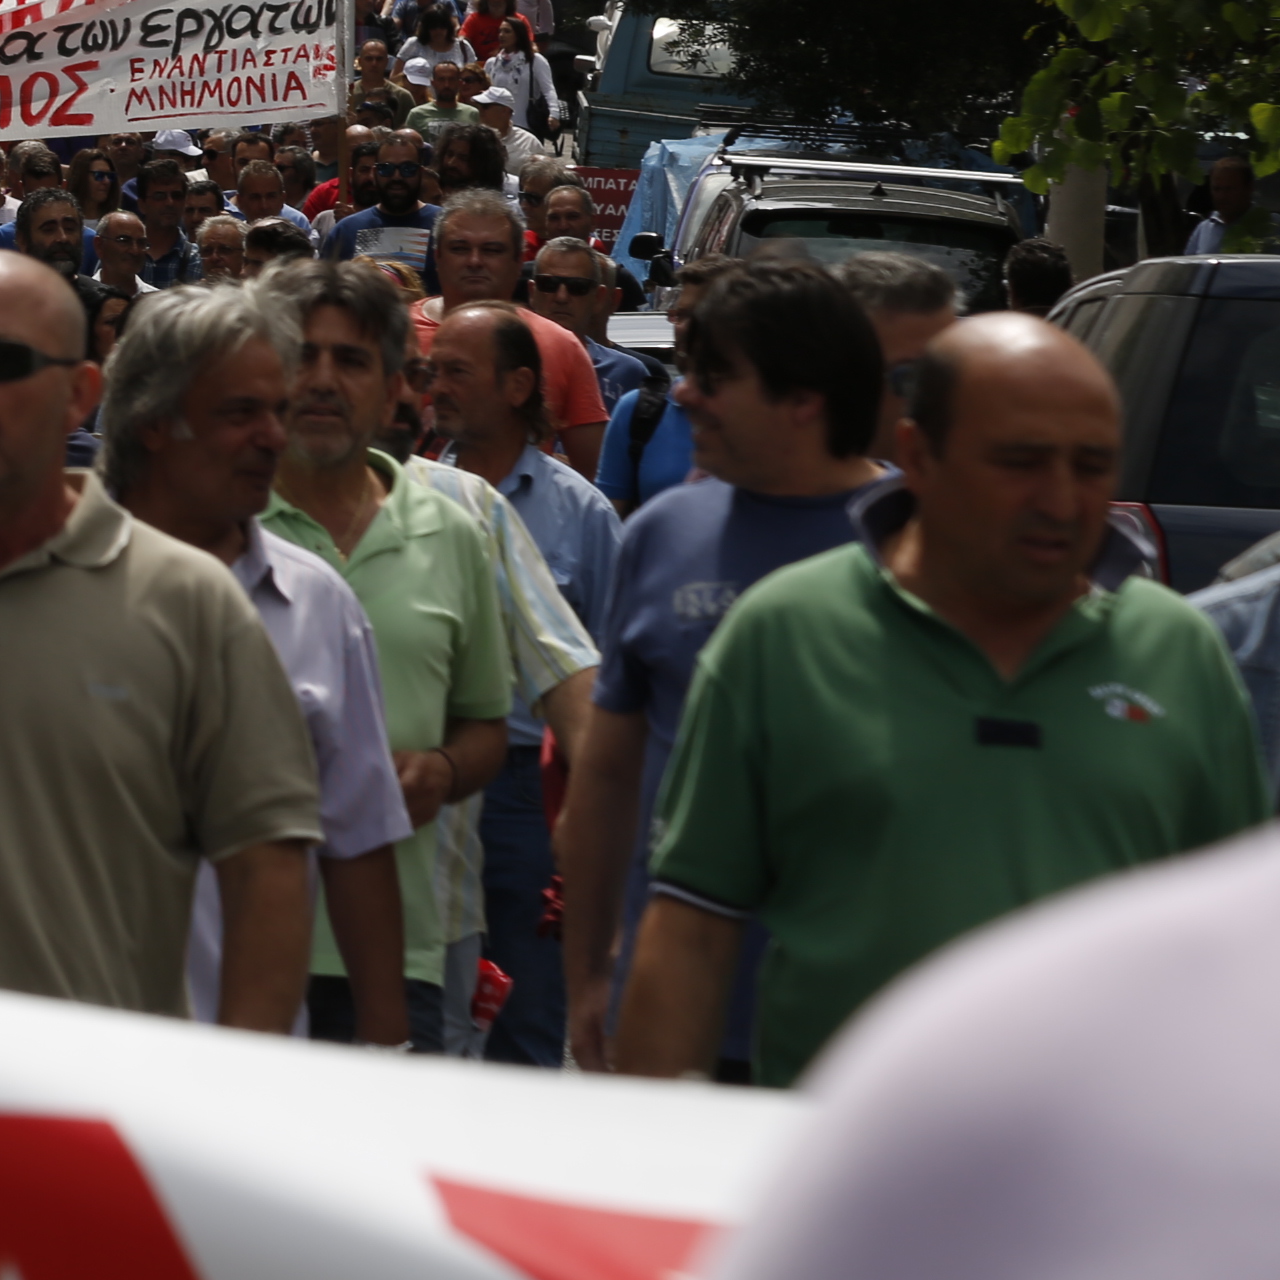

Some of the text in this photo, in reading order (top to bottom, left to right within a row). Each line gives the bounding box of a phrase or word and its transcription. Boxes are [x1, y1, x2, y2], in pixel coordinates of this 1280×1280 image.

[52, 16, 133, 59] των
[129, 48, 258, 83] ΕΝΑΝΤΙΑ
[123, 70, 309, 116] ΜΝΗΜΟΝΙΑ
